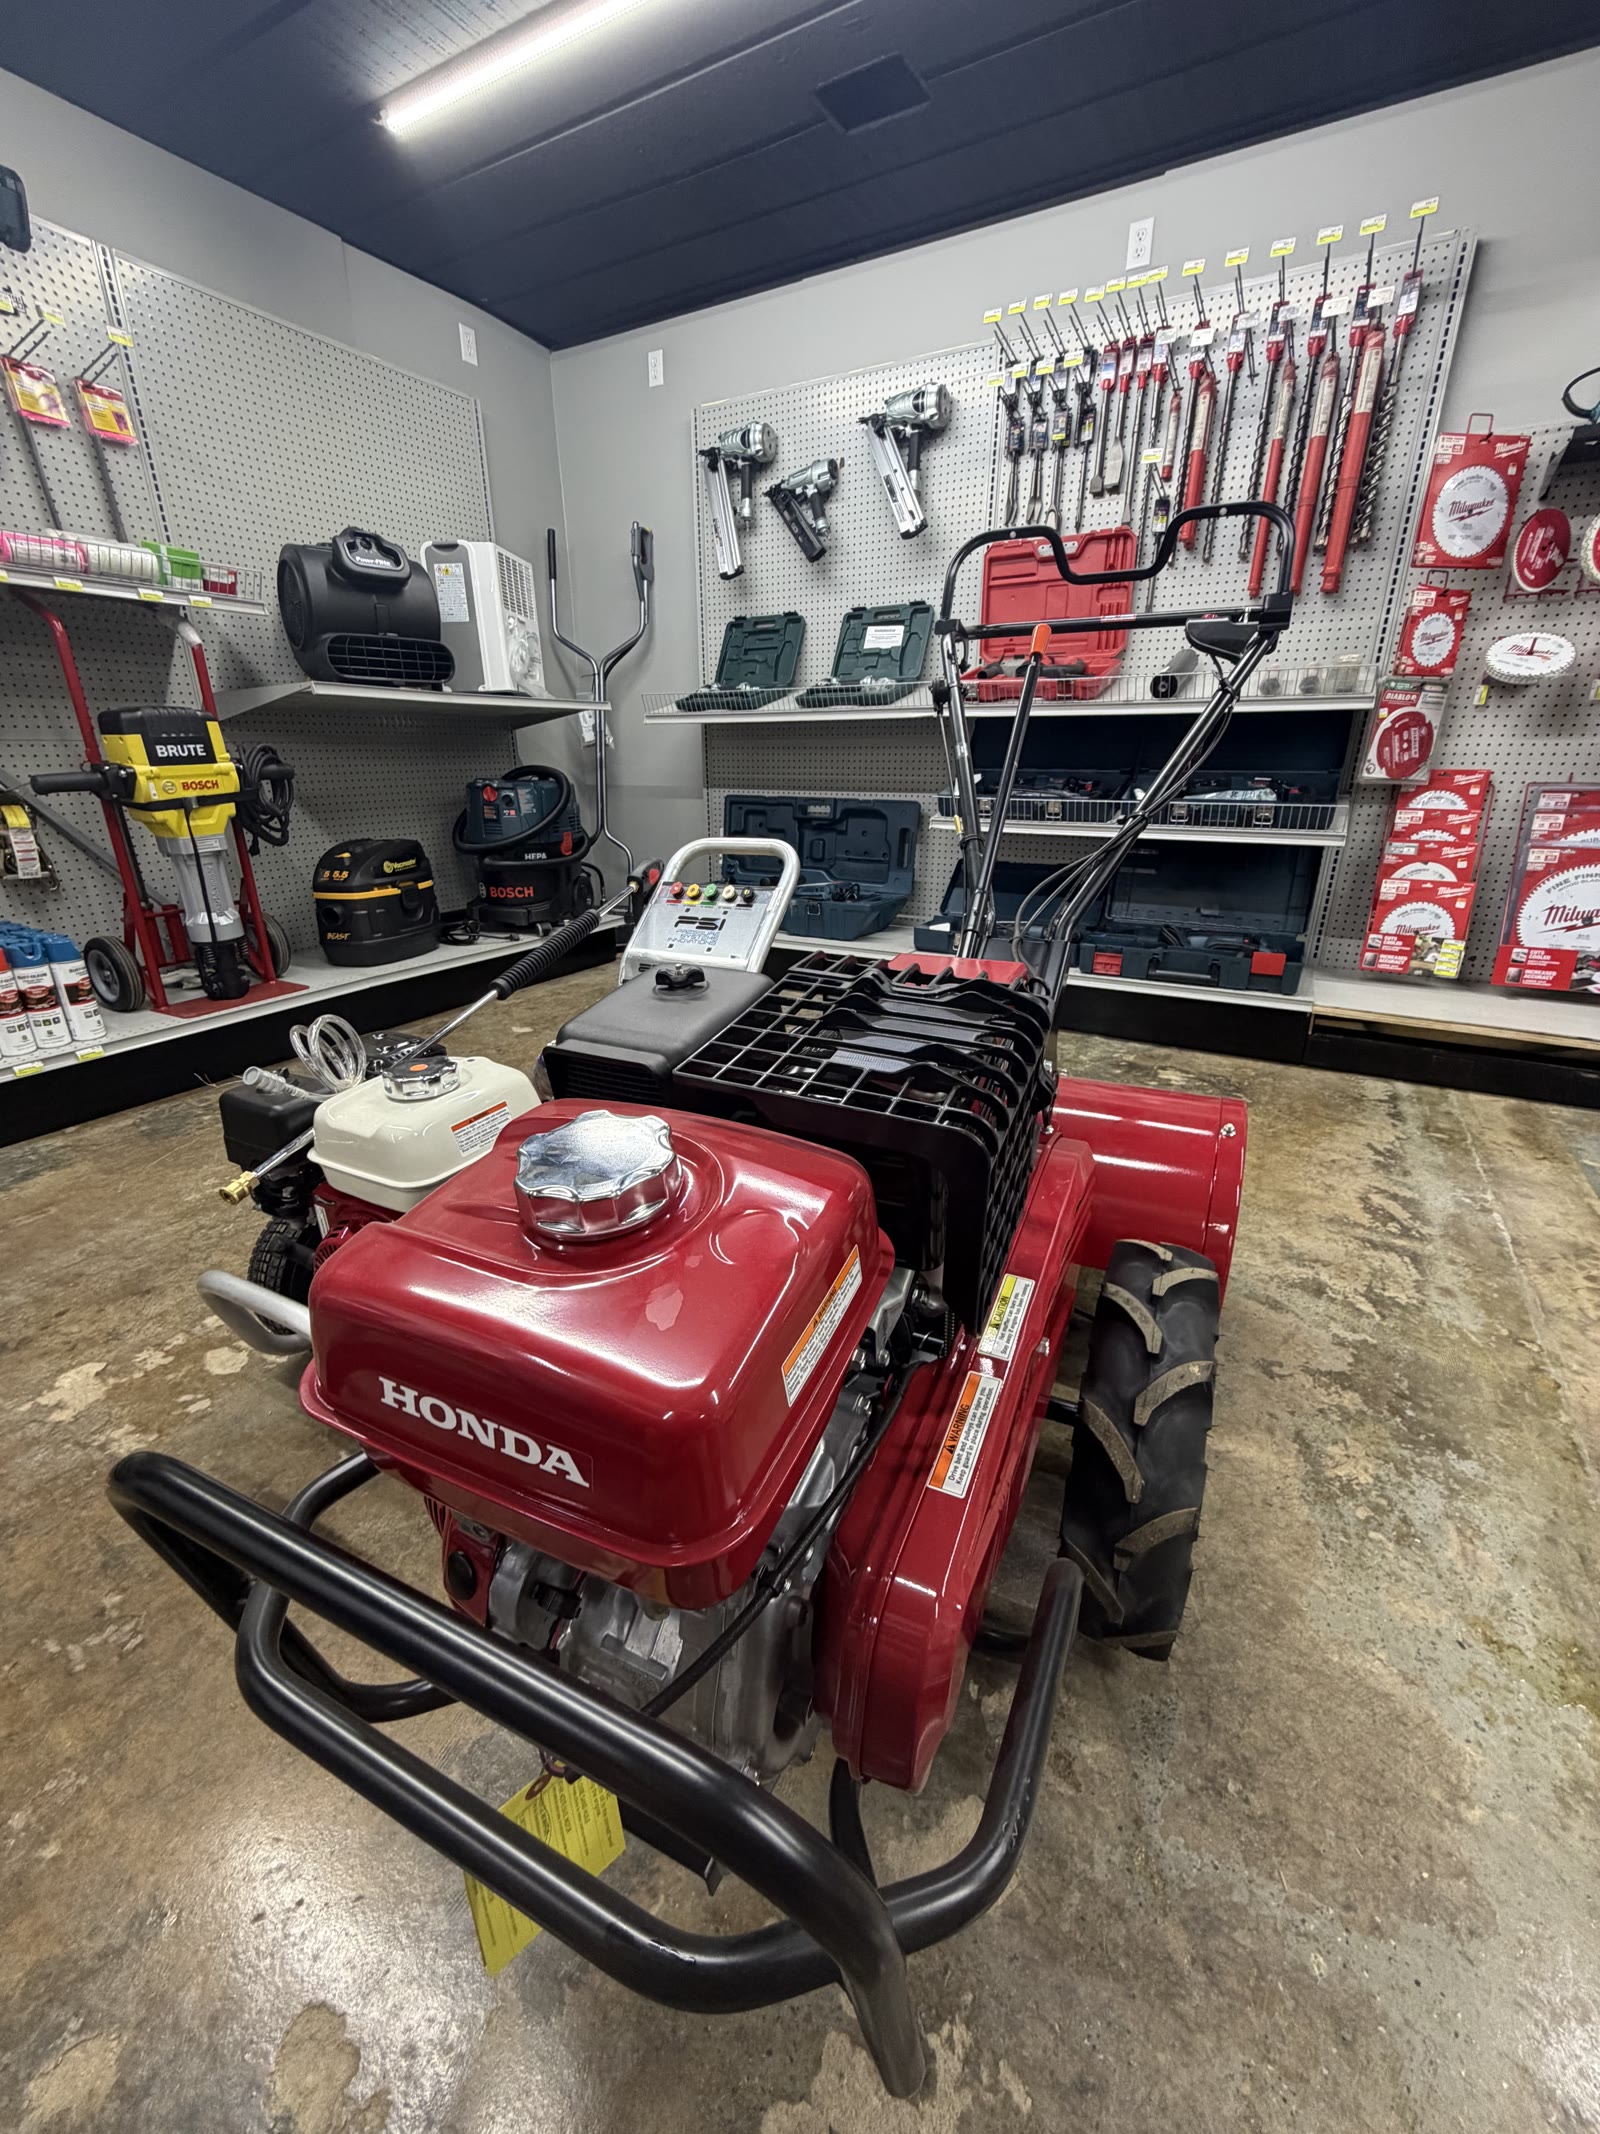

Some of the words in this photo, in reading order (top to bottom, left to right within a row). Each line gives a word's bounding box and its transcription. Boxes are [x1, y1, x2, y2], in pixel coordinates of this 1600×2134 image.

[1495, 441, 1527, 455] Milwaukee
[1449, 497, 1496, 518] Milwaukee
[1419, 631, 1449, 643] Milwaukee
[1385, 692, 1411, 700] DIABLO
[155, 744, 207, 758] BRUTE
[181, 780, 219, 791] BOSCH
[524, 852, 547, 860] HEPA
[1437, 887, 1472, 896] Milwaukee
[1546, 878, 1572, 894] FINE
[489, 886, 535, 899] BOSCH
[674, 915, 727, 931] PSI
[1395, 924, 1441, 934] Milwaukee
[326, 932, 351, 940] BEAST
[667, 937, 717, 946] INNOVATIONS
[680, 934, 720, 942] SYSTEMS
[1524, 969, 1557, 977] INCREASED
[992, 1295, 1009, 1322] CAUTION
[1000, 1344, 1008, 1354] Stay
[978, 1385, 988, 1397] you.
[972, 1396, 984, 1411] injure
[947, 1402, 970, 1443] WARNING
[969, 1411, 978, 1422] can
[378, 1376, 590, 1488] HONDA
[954, 1468, 967, 1485] Keep
[961, 1450, 973, 1469] guard
[969, 1428, 981, 1445] place
[975, 1411, 987, 1429] during
[981, 1386, 996, 1412] operation.
[961, 1421, 975, 1442] pulleys
[957, 1440, 967, 1452] and
[953, 1451, 963, 1464] belt
[947, 1464, 959, 1481] Drive
